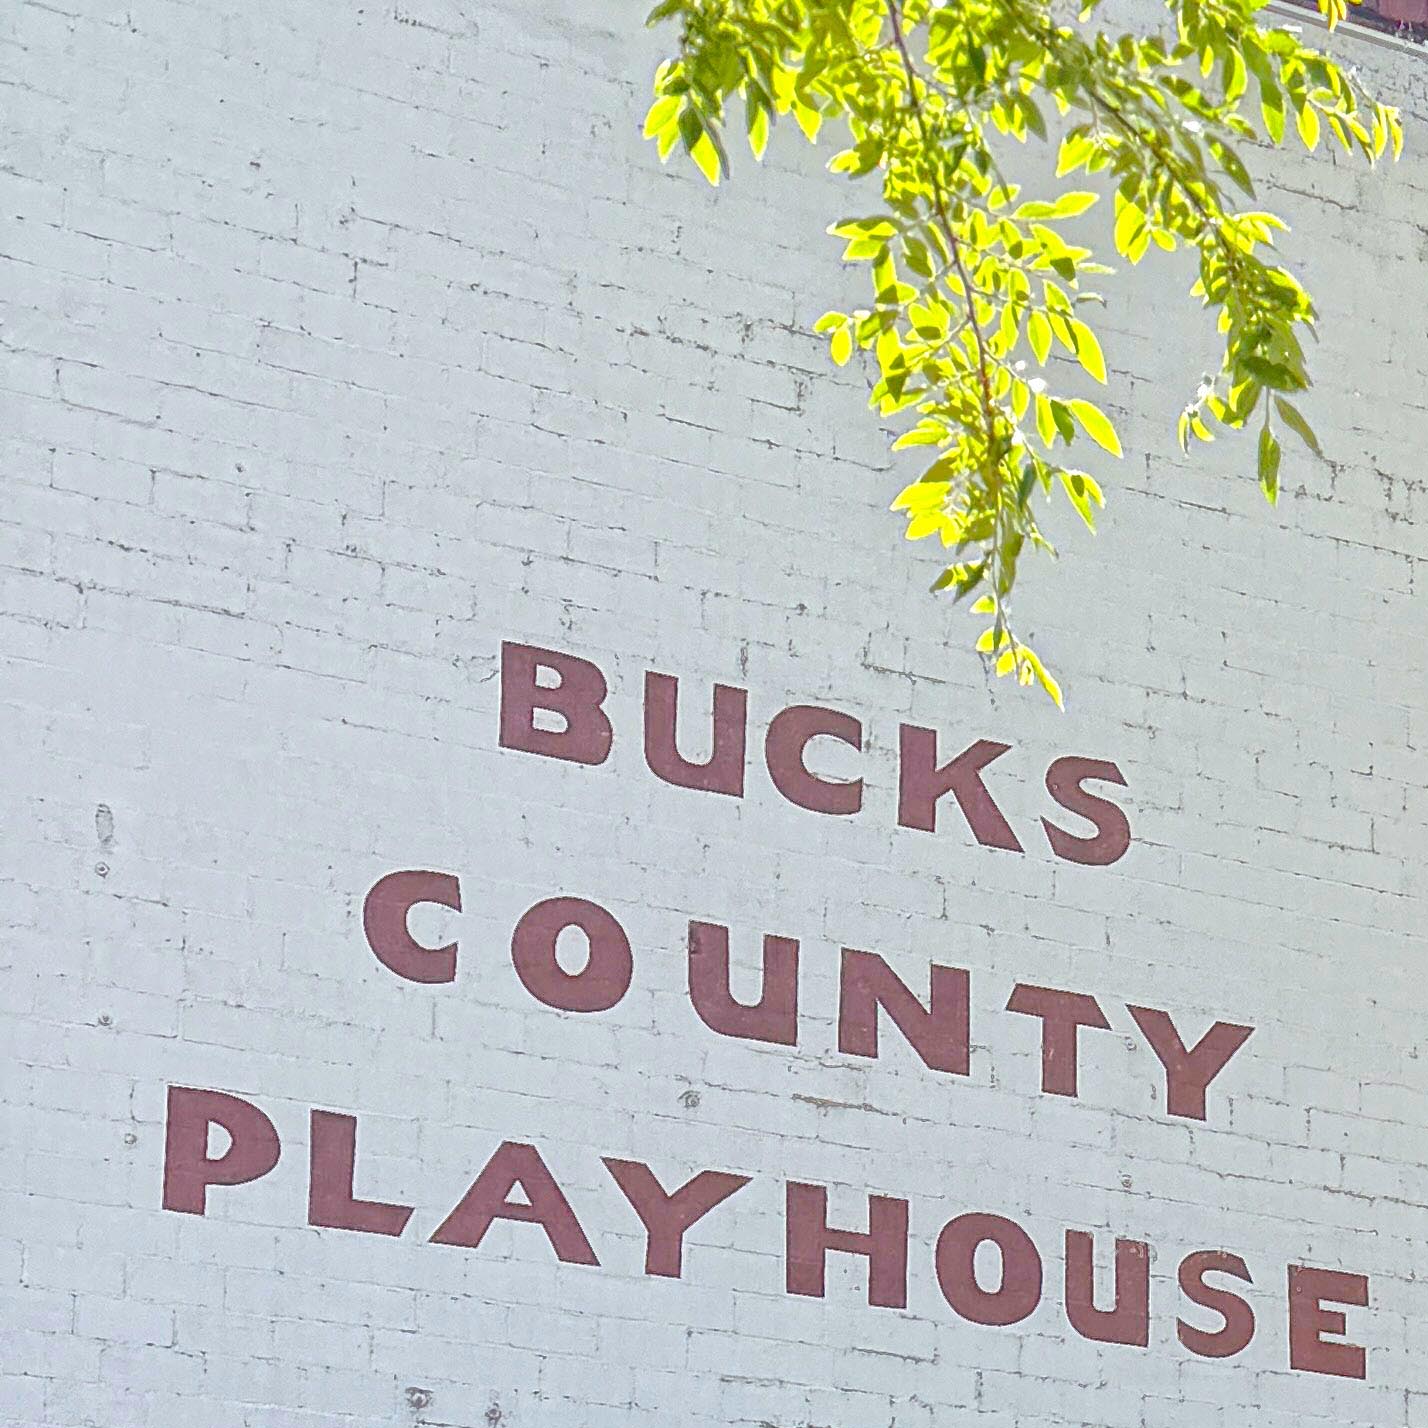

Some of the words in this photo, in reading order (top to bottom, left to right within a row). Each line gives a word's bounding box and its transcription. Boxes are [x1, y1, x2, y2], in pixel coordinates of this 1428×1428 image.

[499, 640, 1131, 867] BUCKS
[363, 869, 1255, 1122] COUNTY
[162, 1085, 1369, 1381] PLAYHOUSE
